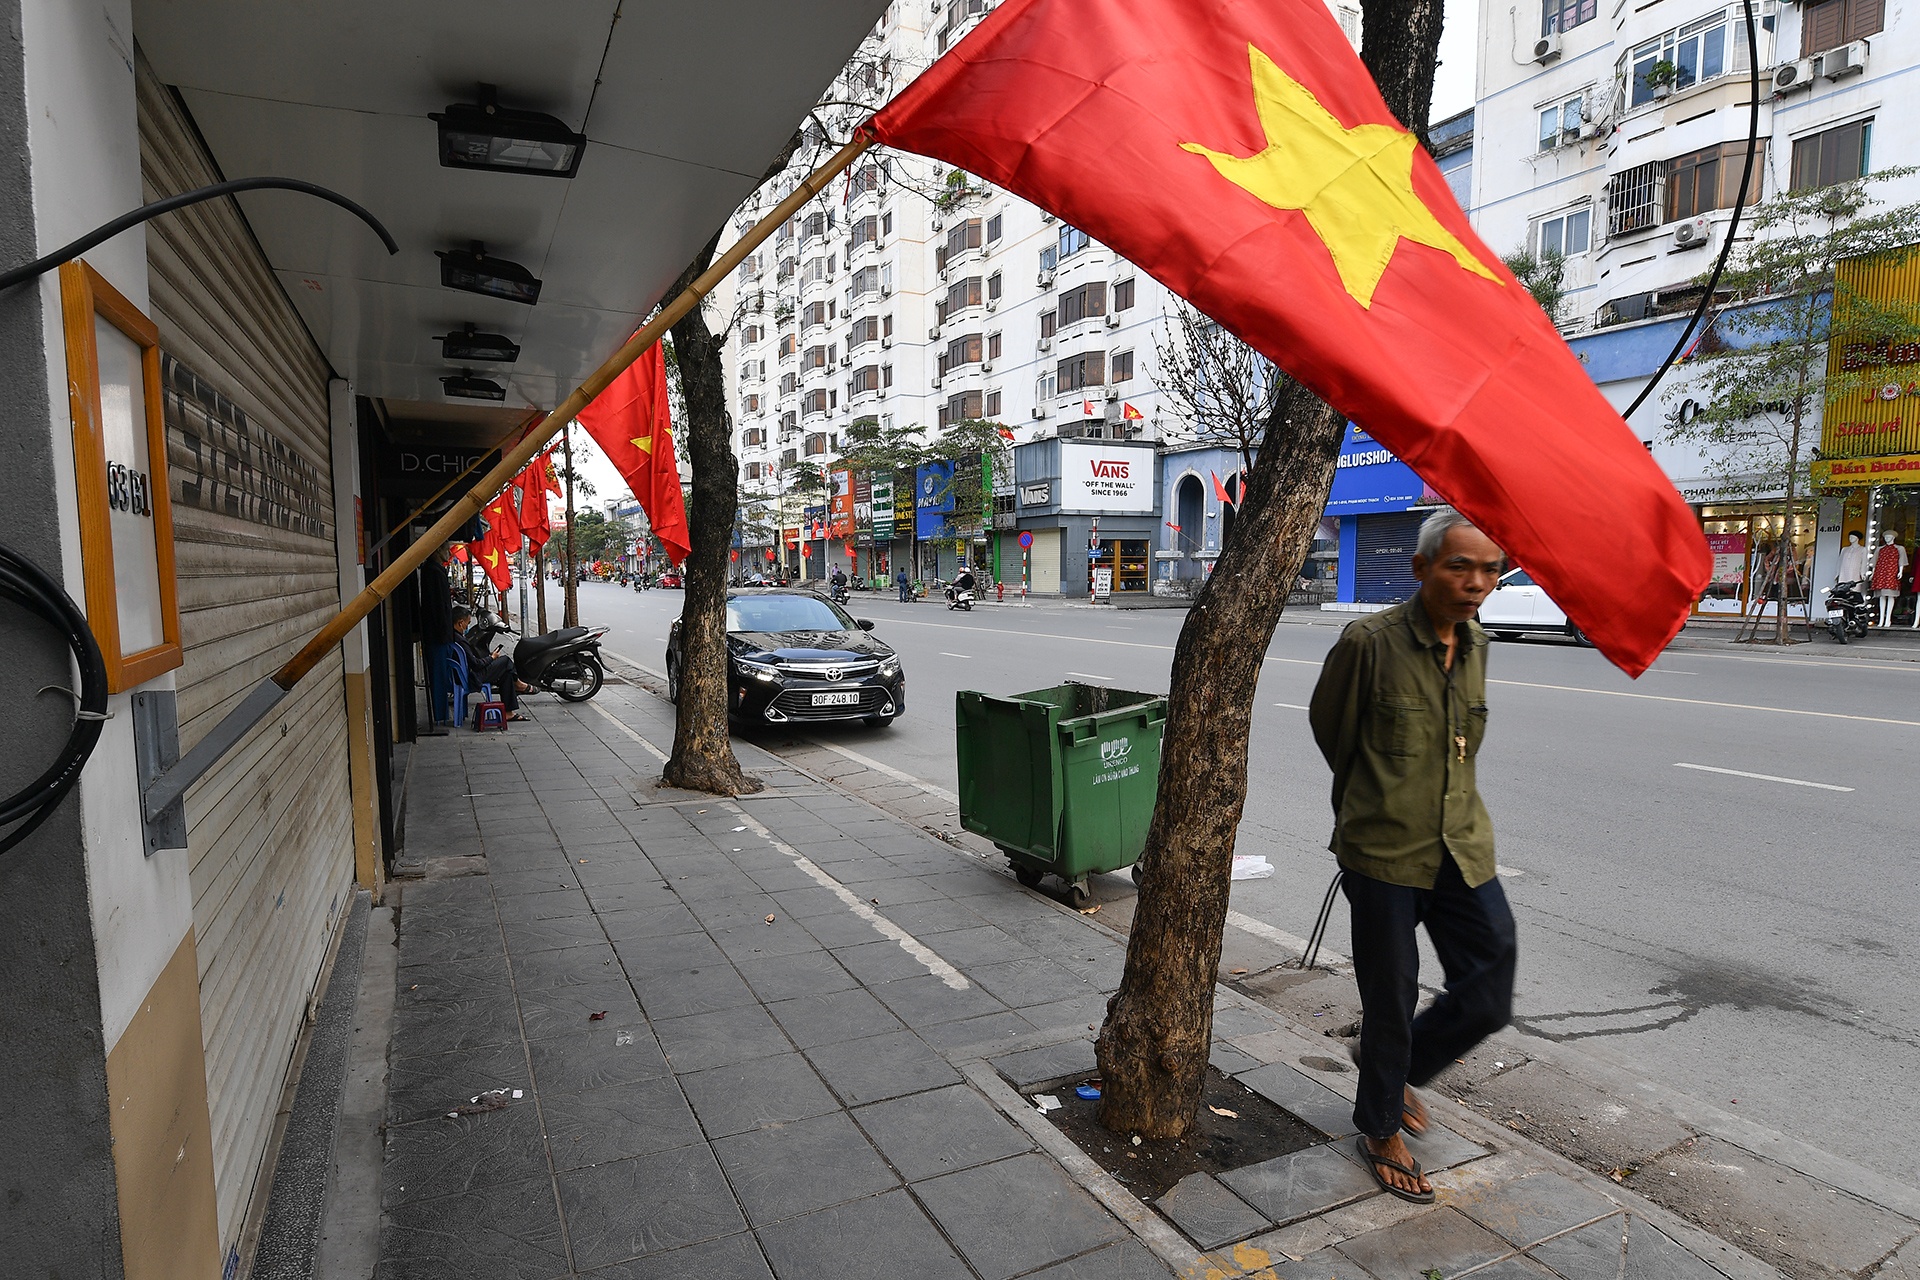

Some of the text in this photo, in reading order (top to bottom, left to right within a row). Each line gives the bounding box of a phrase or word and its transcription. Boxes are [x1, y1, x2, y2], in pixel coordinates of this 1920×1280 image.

[1708, 430, 1758, 443] SINCE 2014
[1090, 459, 1130, 479] VANS
[1831, 459, 1920, 475] Bán Buôn
[1020, 483, 1050, 505] VANS
